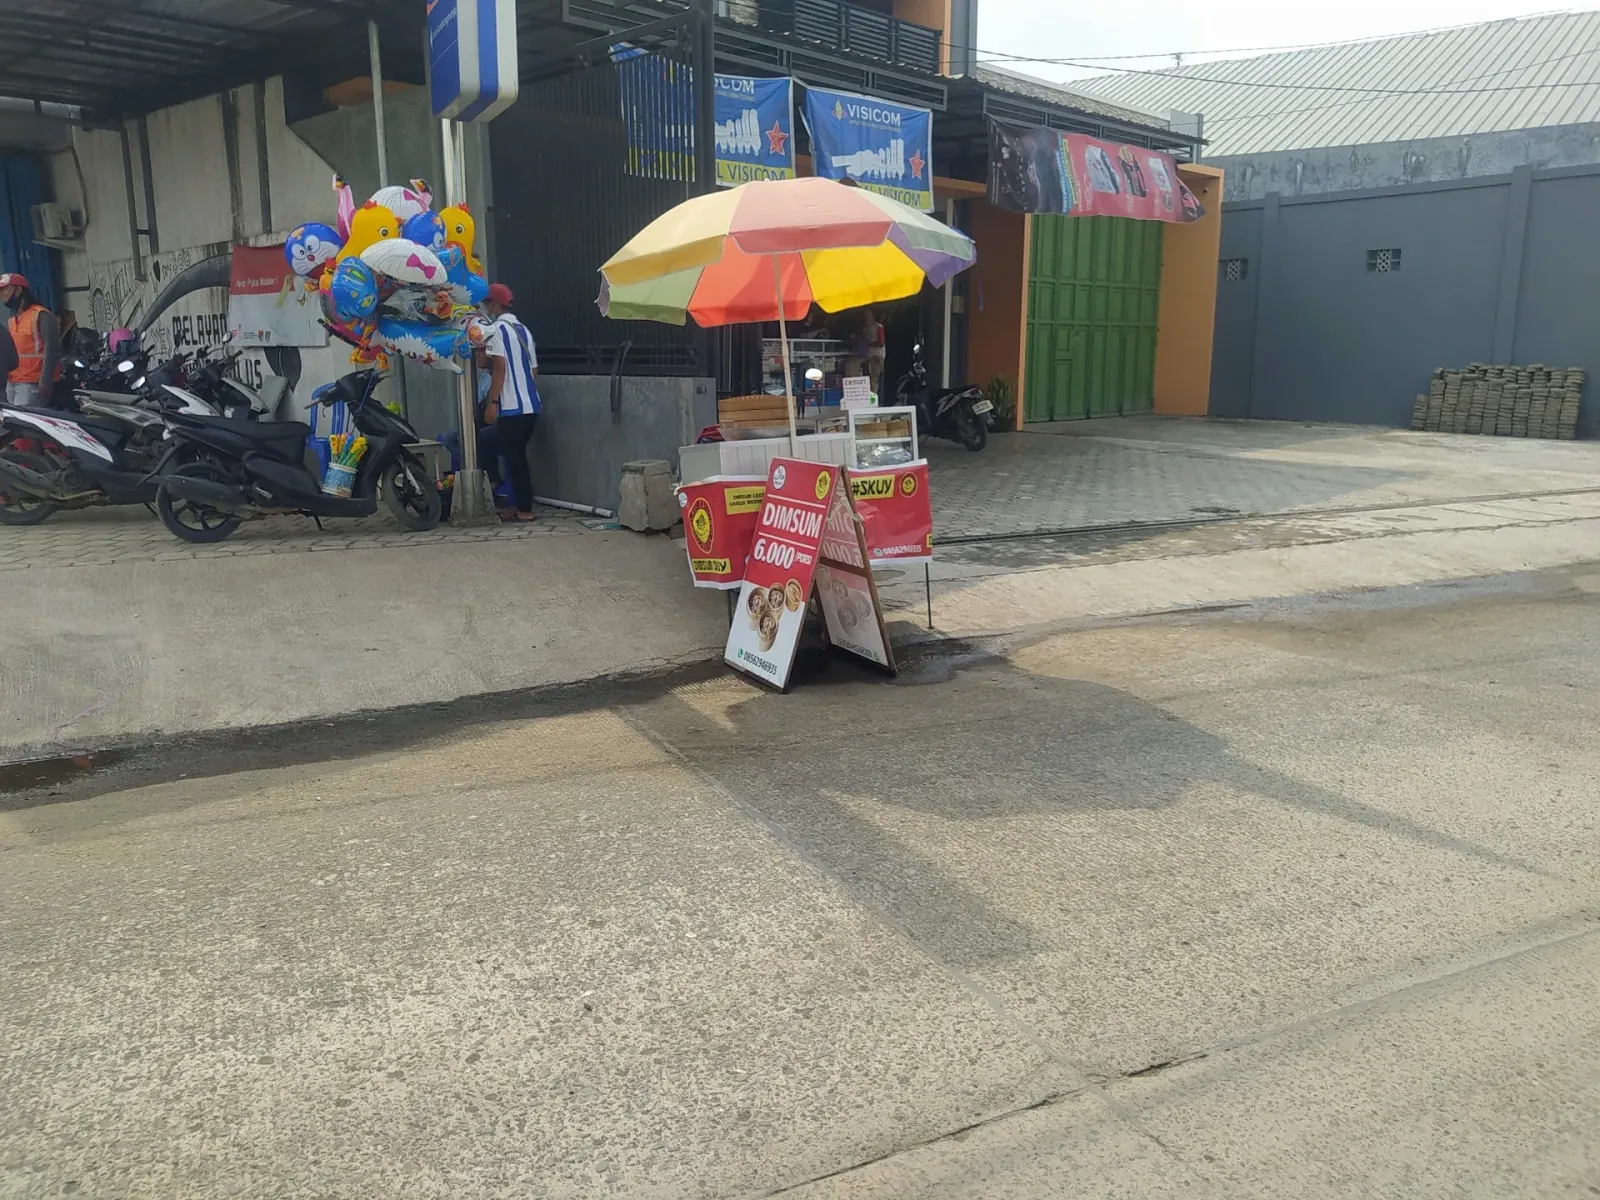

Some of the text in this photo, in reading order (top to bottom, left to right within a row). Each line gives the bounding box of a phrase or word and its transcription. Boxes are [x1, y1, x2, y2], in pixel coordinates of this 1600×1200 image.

[846, 103, 901, 126] VISICOM
[727, 163, 786, 181] VISICOM
[877, 186, 921, 207] VISICOM
[235, 279, 247, 289] Ayo
[247, 278, 259, 287] Pakai
[851, 478, 893, 496] #SKUY
[762, 502, 823, 538] DIMSUM
[754, 538, 795, 570] 6.000
[743, 651, 778, 676] 08562946935
